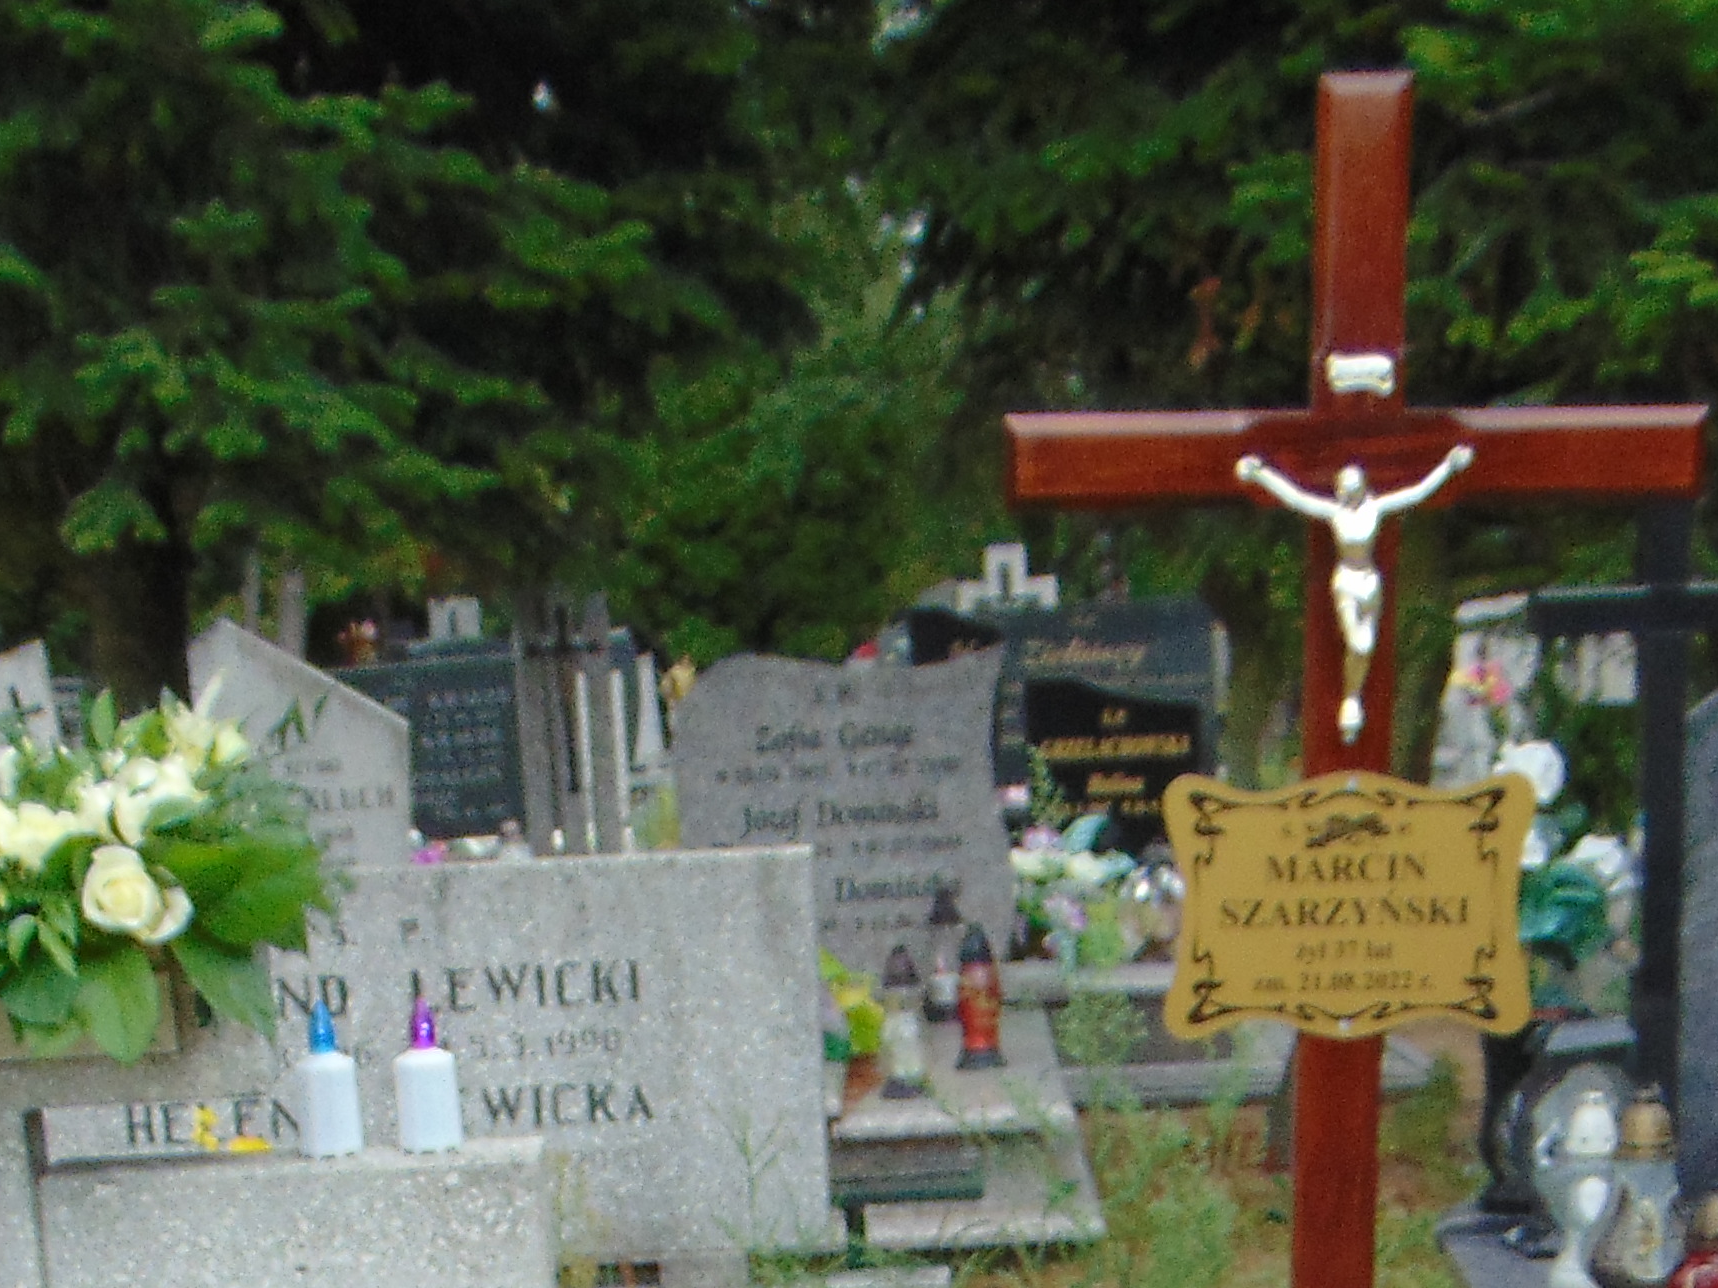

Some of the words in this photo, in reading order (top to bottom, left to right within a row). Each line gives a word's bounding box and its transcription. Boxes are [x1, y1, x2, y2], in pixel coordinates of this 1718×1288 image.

[1265, 853, 1428, 883] MARCIN
[1218, 889, 1470, 928] SZARZYŃSKI
[408, 957, 643, 1018] LEWICKI
[481, 1082, 657, 1130] WICKA
